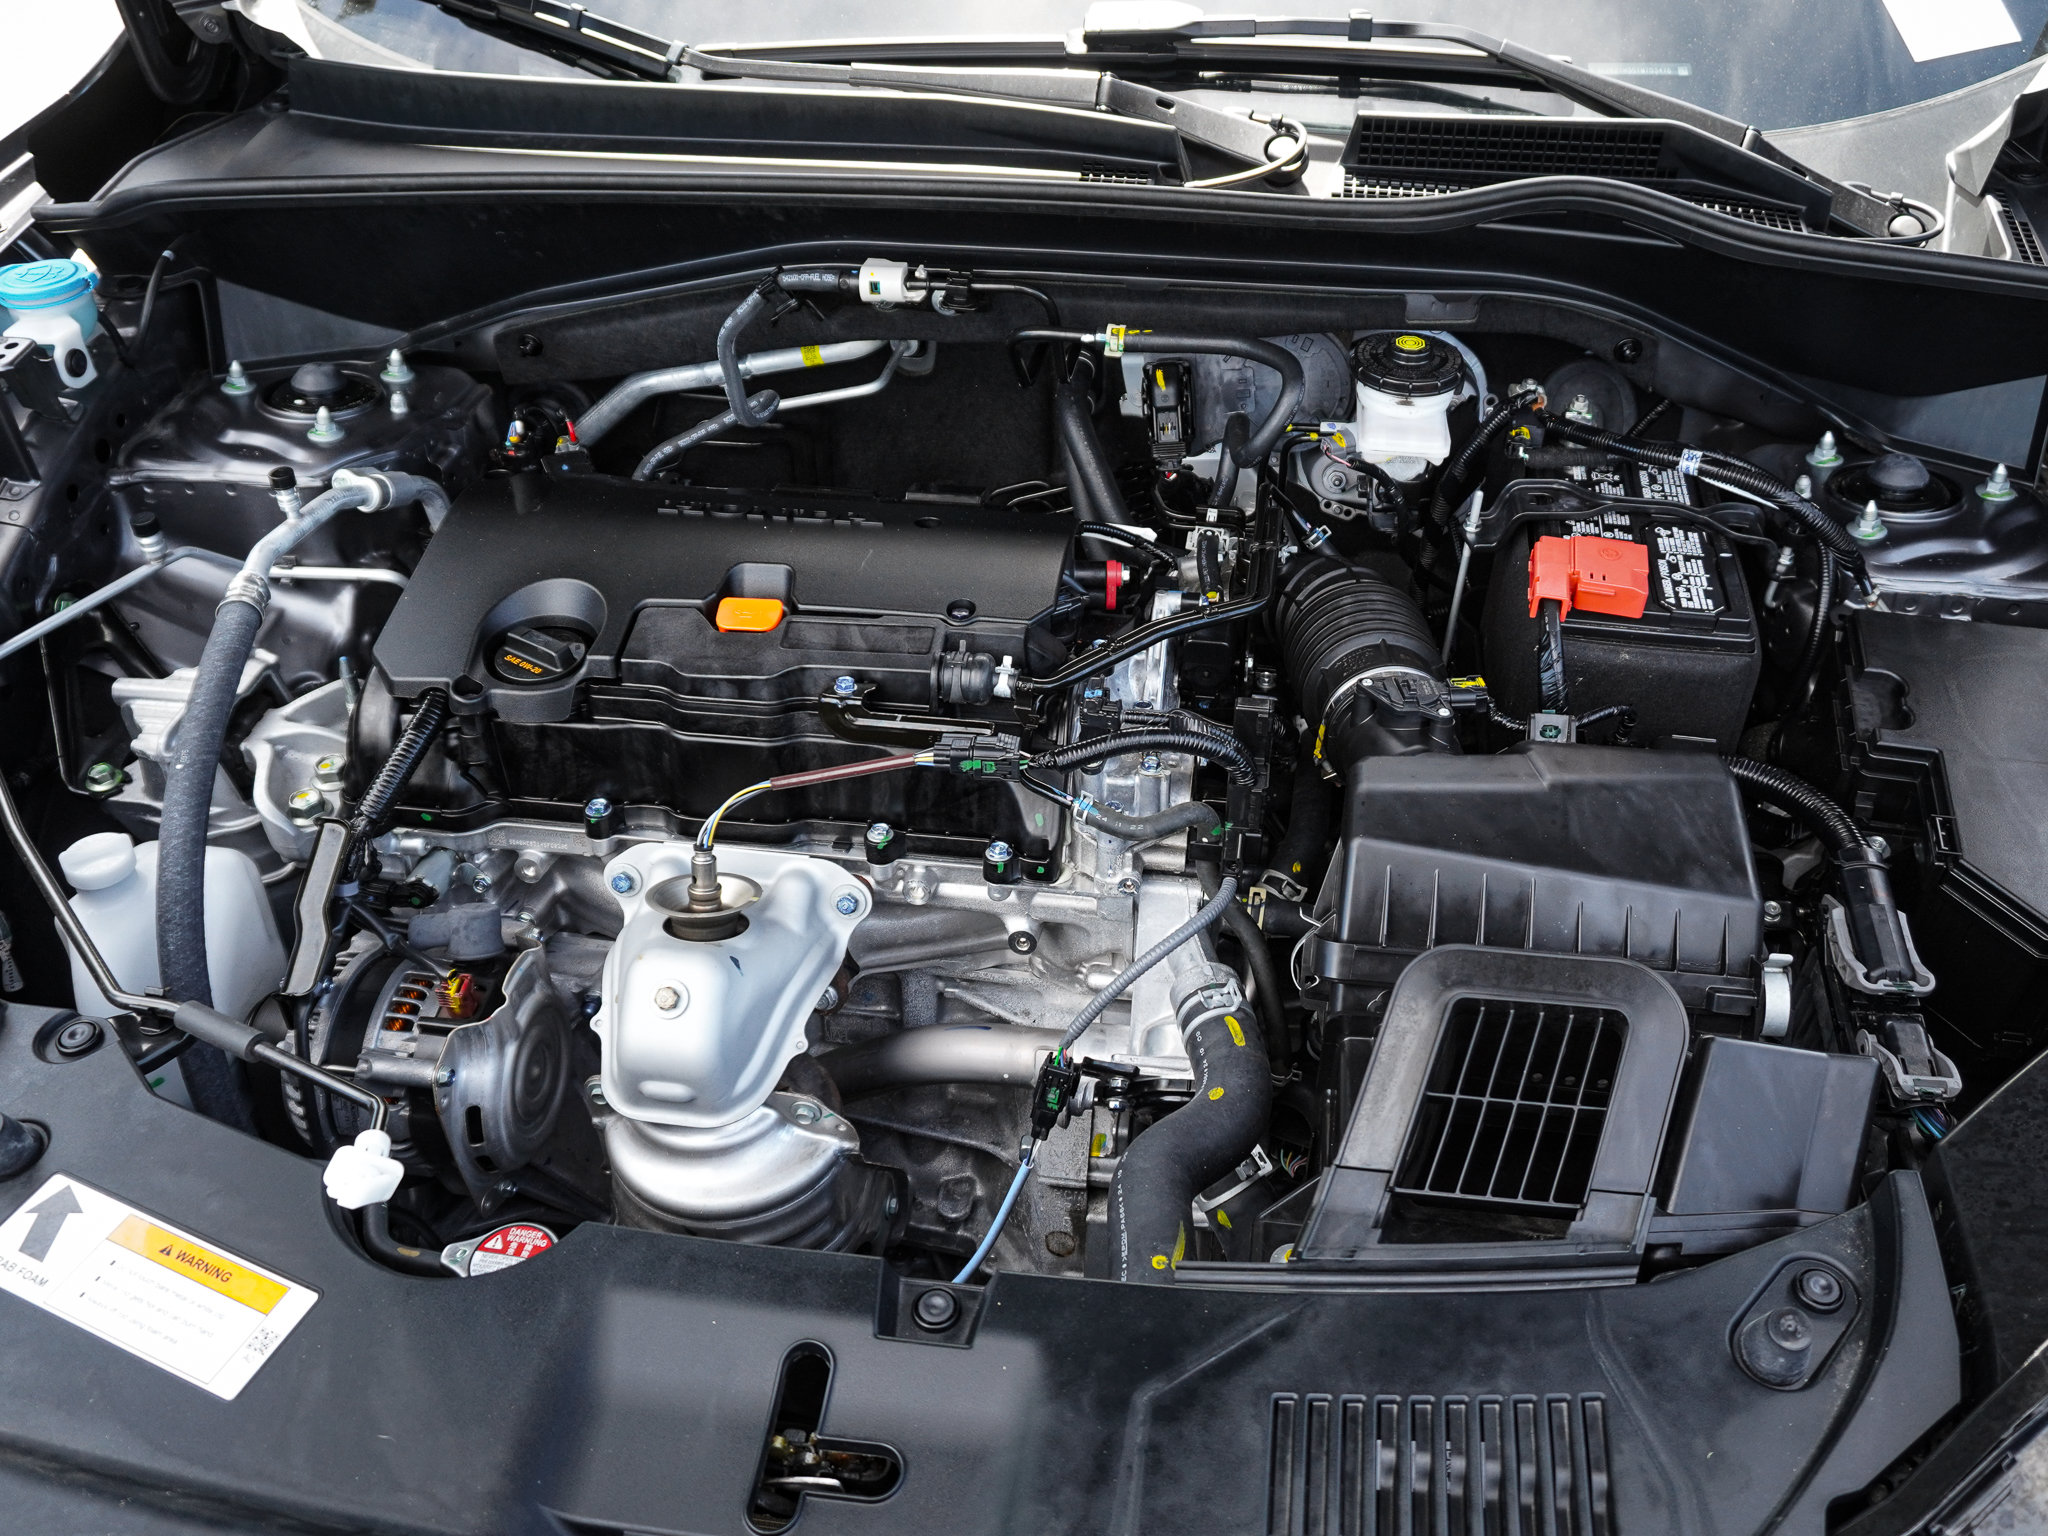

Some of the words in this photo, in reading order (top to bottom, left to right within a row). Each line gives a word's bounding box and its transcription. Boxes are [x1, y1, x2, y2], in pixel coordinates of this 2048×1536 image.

[504, 655, 522, 666] SAE
[520, 661, 543, 674] 0W-20
[506, 1234, 548, 1248] WARNUNG
[509, 1227, 543, 1238] DANGER
[175, 1249, 233, 1283] WARNING
[16, 1266, 49, 1287] FOAM
